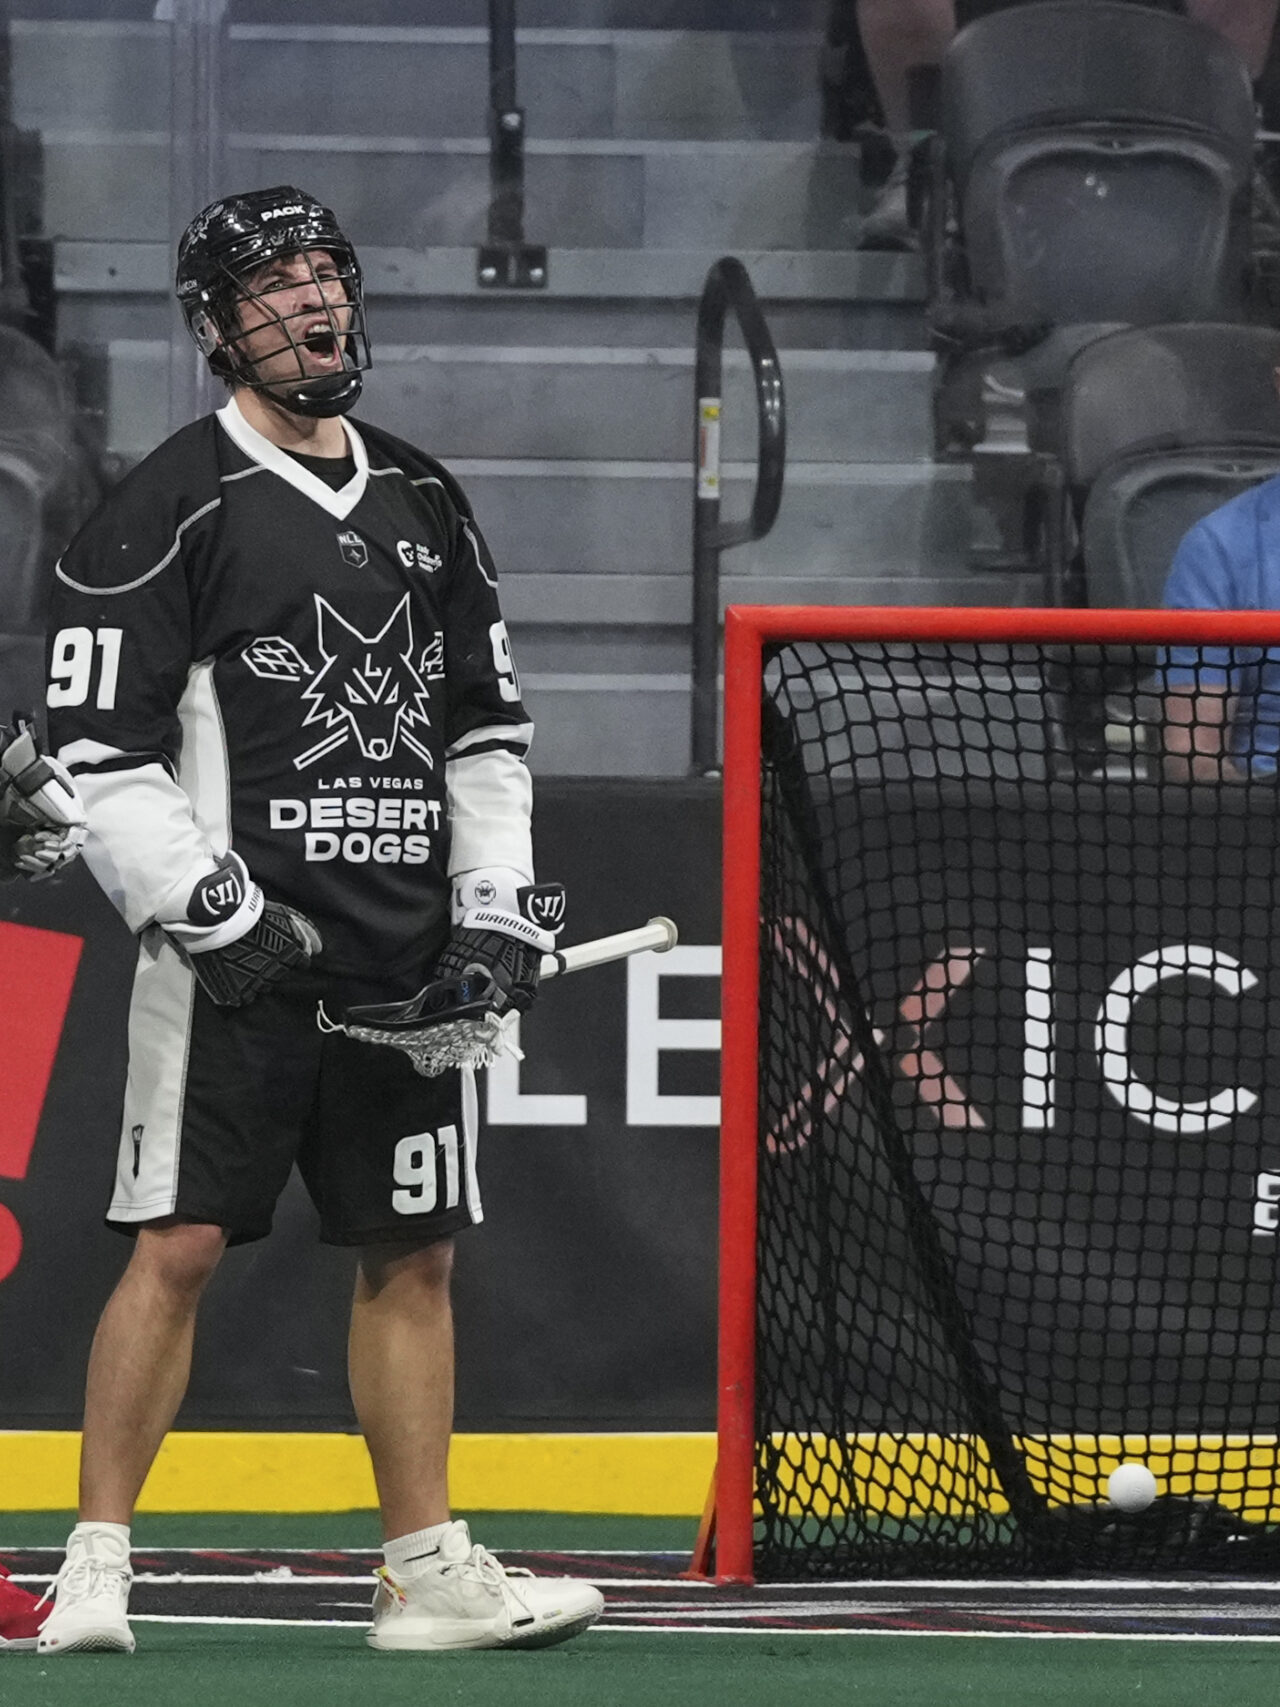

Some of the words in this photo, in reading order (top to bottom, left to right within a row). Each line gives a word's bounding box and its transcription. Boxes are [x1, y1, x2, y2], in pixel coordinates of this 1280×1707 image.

[260, 204, 306, 222] PACK
[46, 626, 123, 710] 91
[488, 619, 521, 702] 9
[317, 776, 363, 790] LAS
[368, 776, 424, 790] VEGAS
[269, 797, 442, 831] DESERT
[304, 831, 431, 865] DOGS
[474, 912, 541, 940] WARRIOR
[391, 1124, 460, 1216] 91
